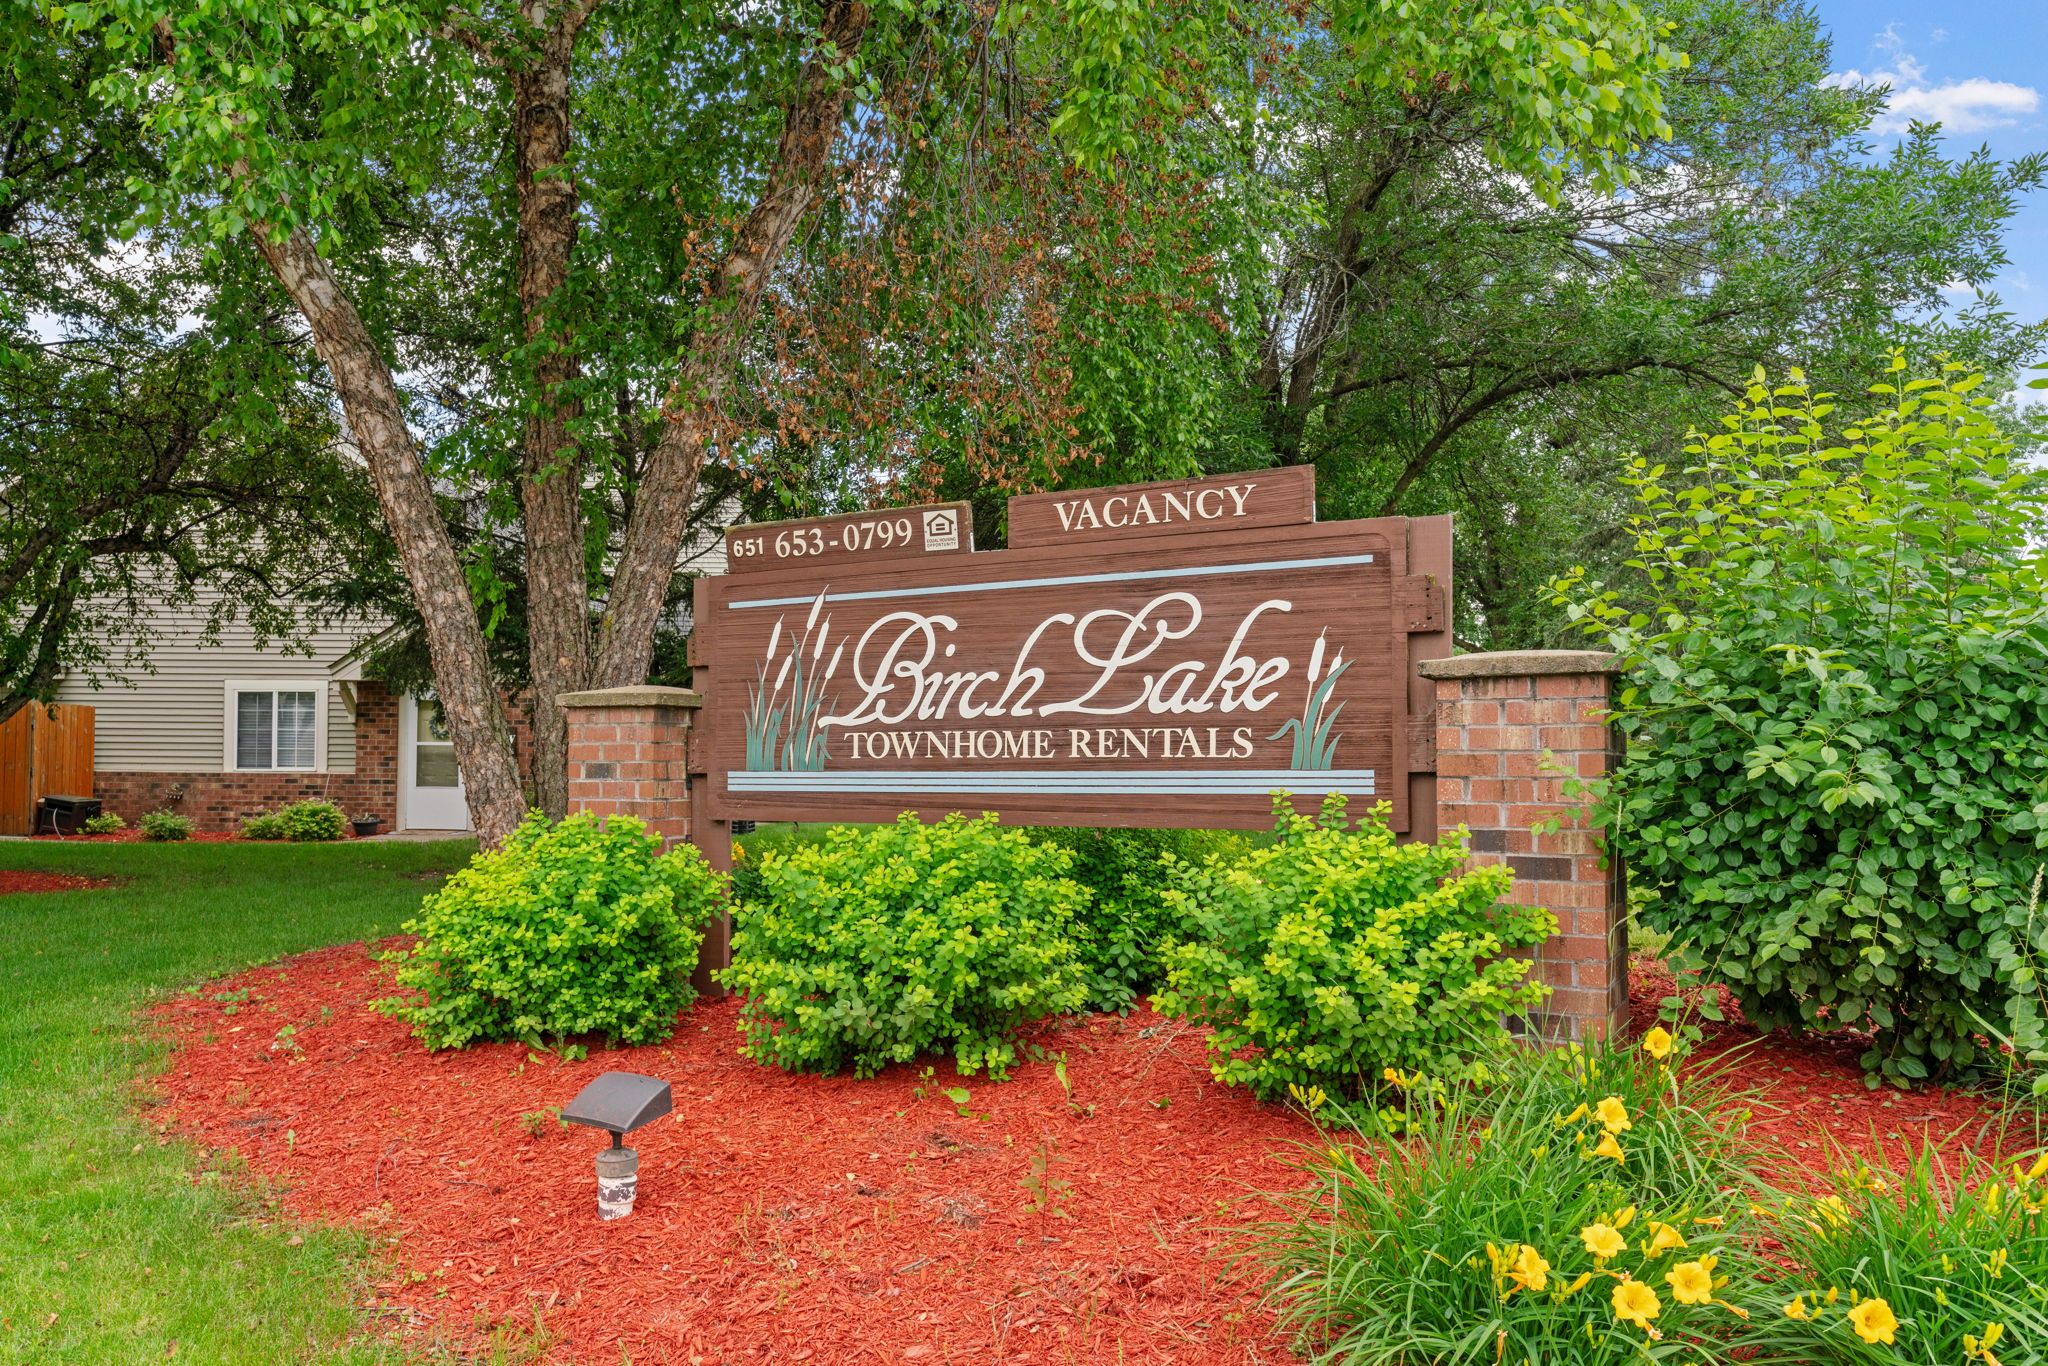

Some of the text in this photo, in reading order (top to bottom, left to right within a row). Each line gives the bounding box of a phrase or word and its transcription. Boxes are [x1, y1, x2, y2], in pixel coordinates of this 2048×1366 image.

[1053, 483, 1257, 532] VACANCY
[733, 518, 913, 558] 651 653-0799
[818, 591, 1293, 729] Birch Lake
[843, 726, 1254, 760] TOWNHOME RENTALS
